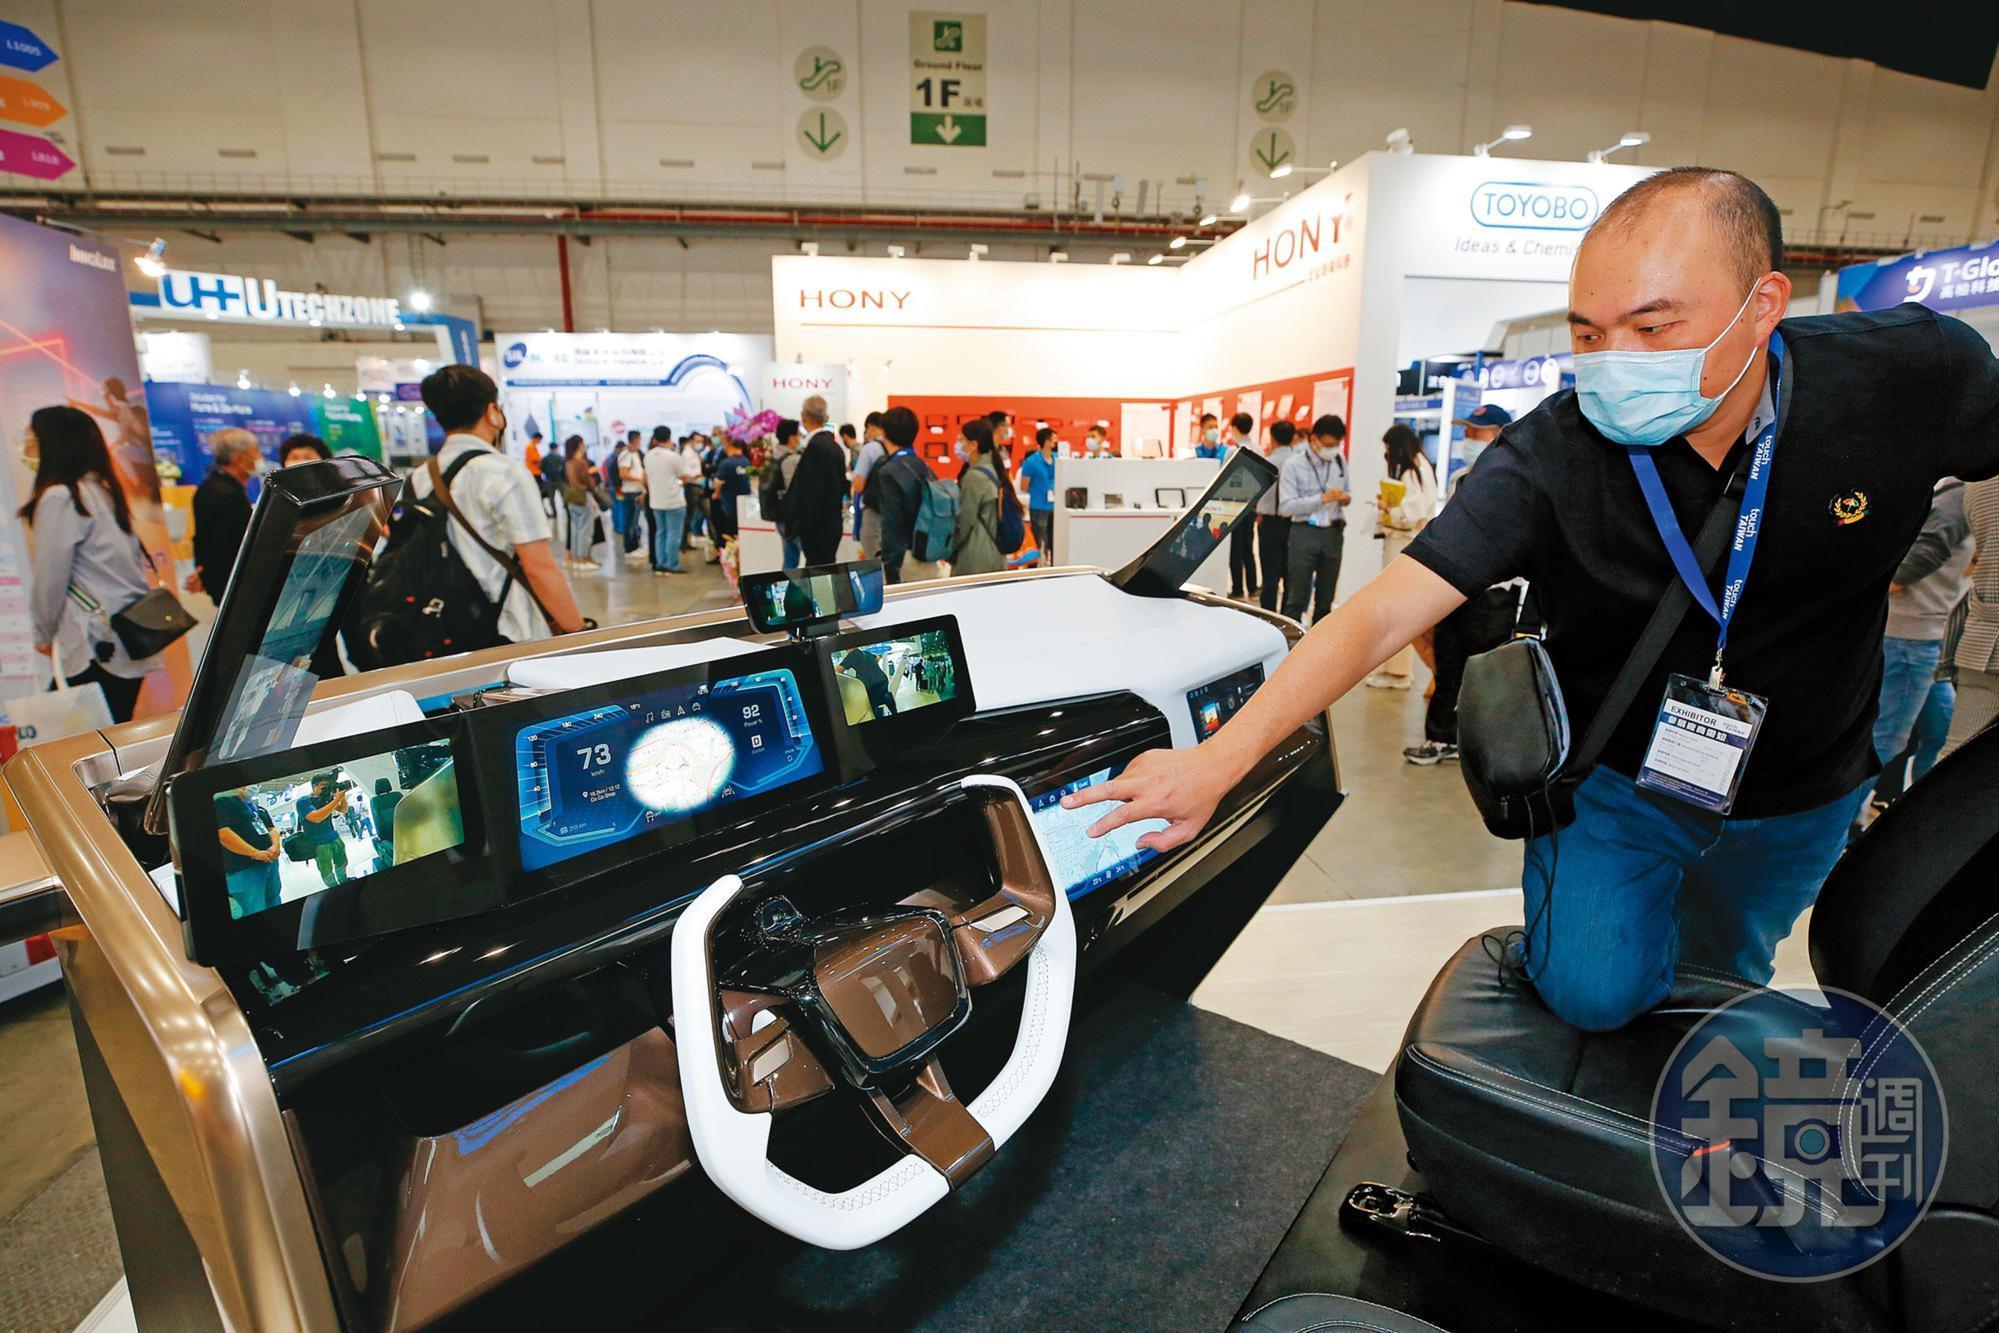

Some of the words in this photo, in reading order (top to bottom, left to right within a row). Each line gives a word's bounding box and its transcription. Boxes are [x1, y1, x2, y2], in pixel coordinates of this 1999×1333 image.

[913, 58, 952, 70] Ground
[955, 60, 983, 71] Floor
[915, 77, 961, 107] 1F
[1484, 192, 1588, 220] TOYOBO
[1253, 191, 1352, 281] HONY
[1454, 237, 1501, 253] Ideas
[1506, 239, 1517, 253] &
[800, 289, 911, 309] HONY
[772, 378, 833, 389] HONY
[1750, 443, 1765, 480] TAIWAN
[1760, 435, 1773, 465] touch
[1733, 515, 1749, 552] TAIWAN
[1745, 508, 1760, 538] touch
[1722, 585, 1734, 620] TAIWAN
[1730, 579, 1744, 607] touch
[742, 704, 760, 719] 92
[1670, 705, 1717, 727] EXHIBITOR
[577, 743, 611, 770] 73
